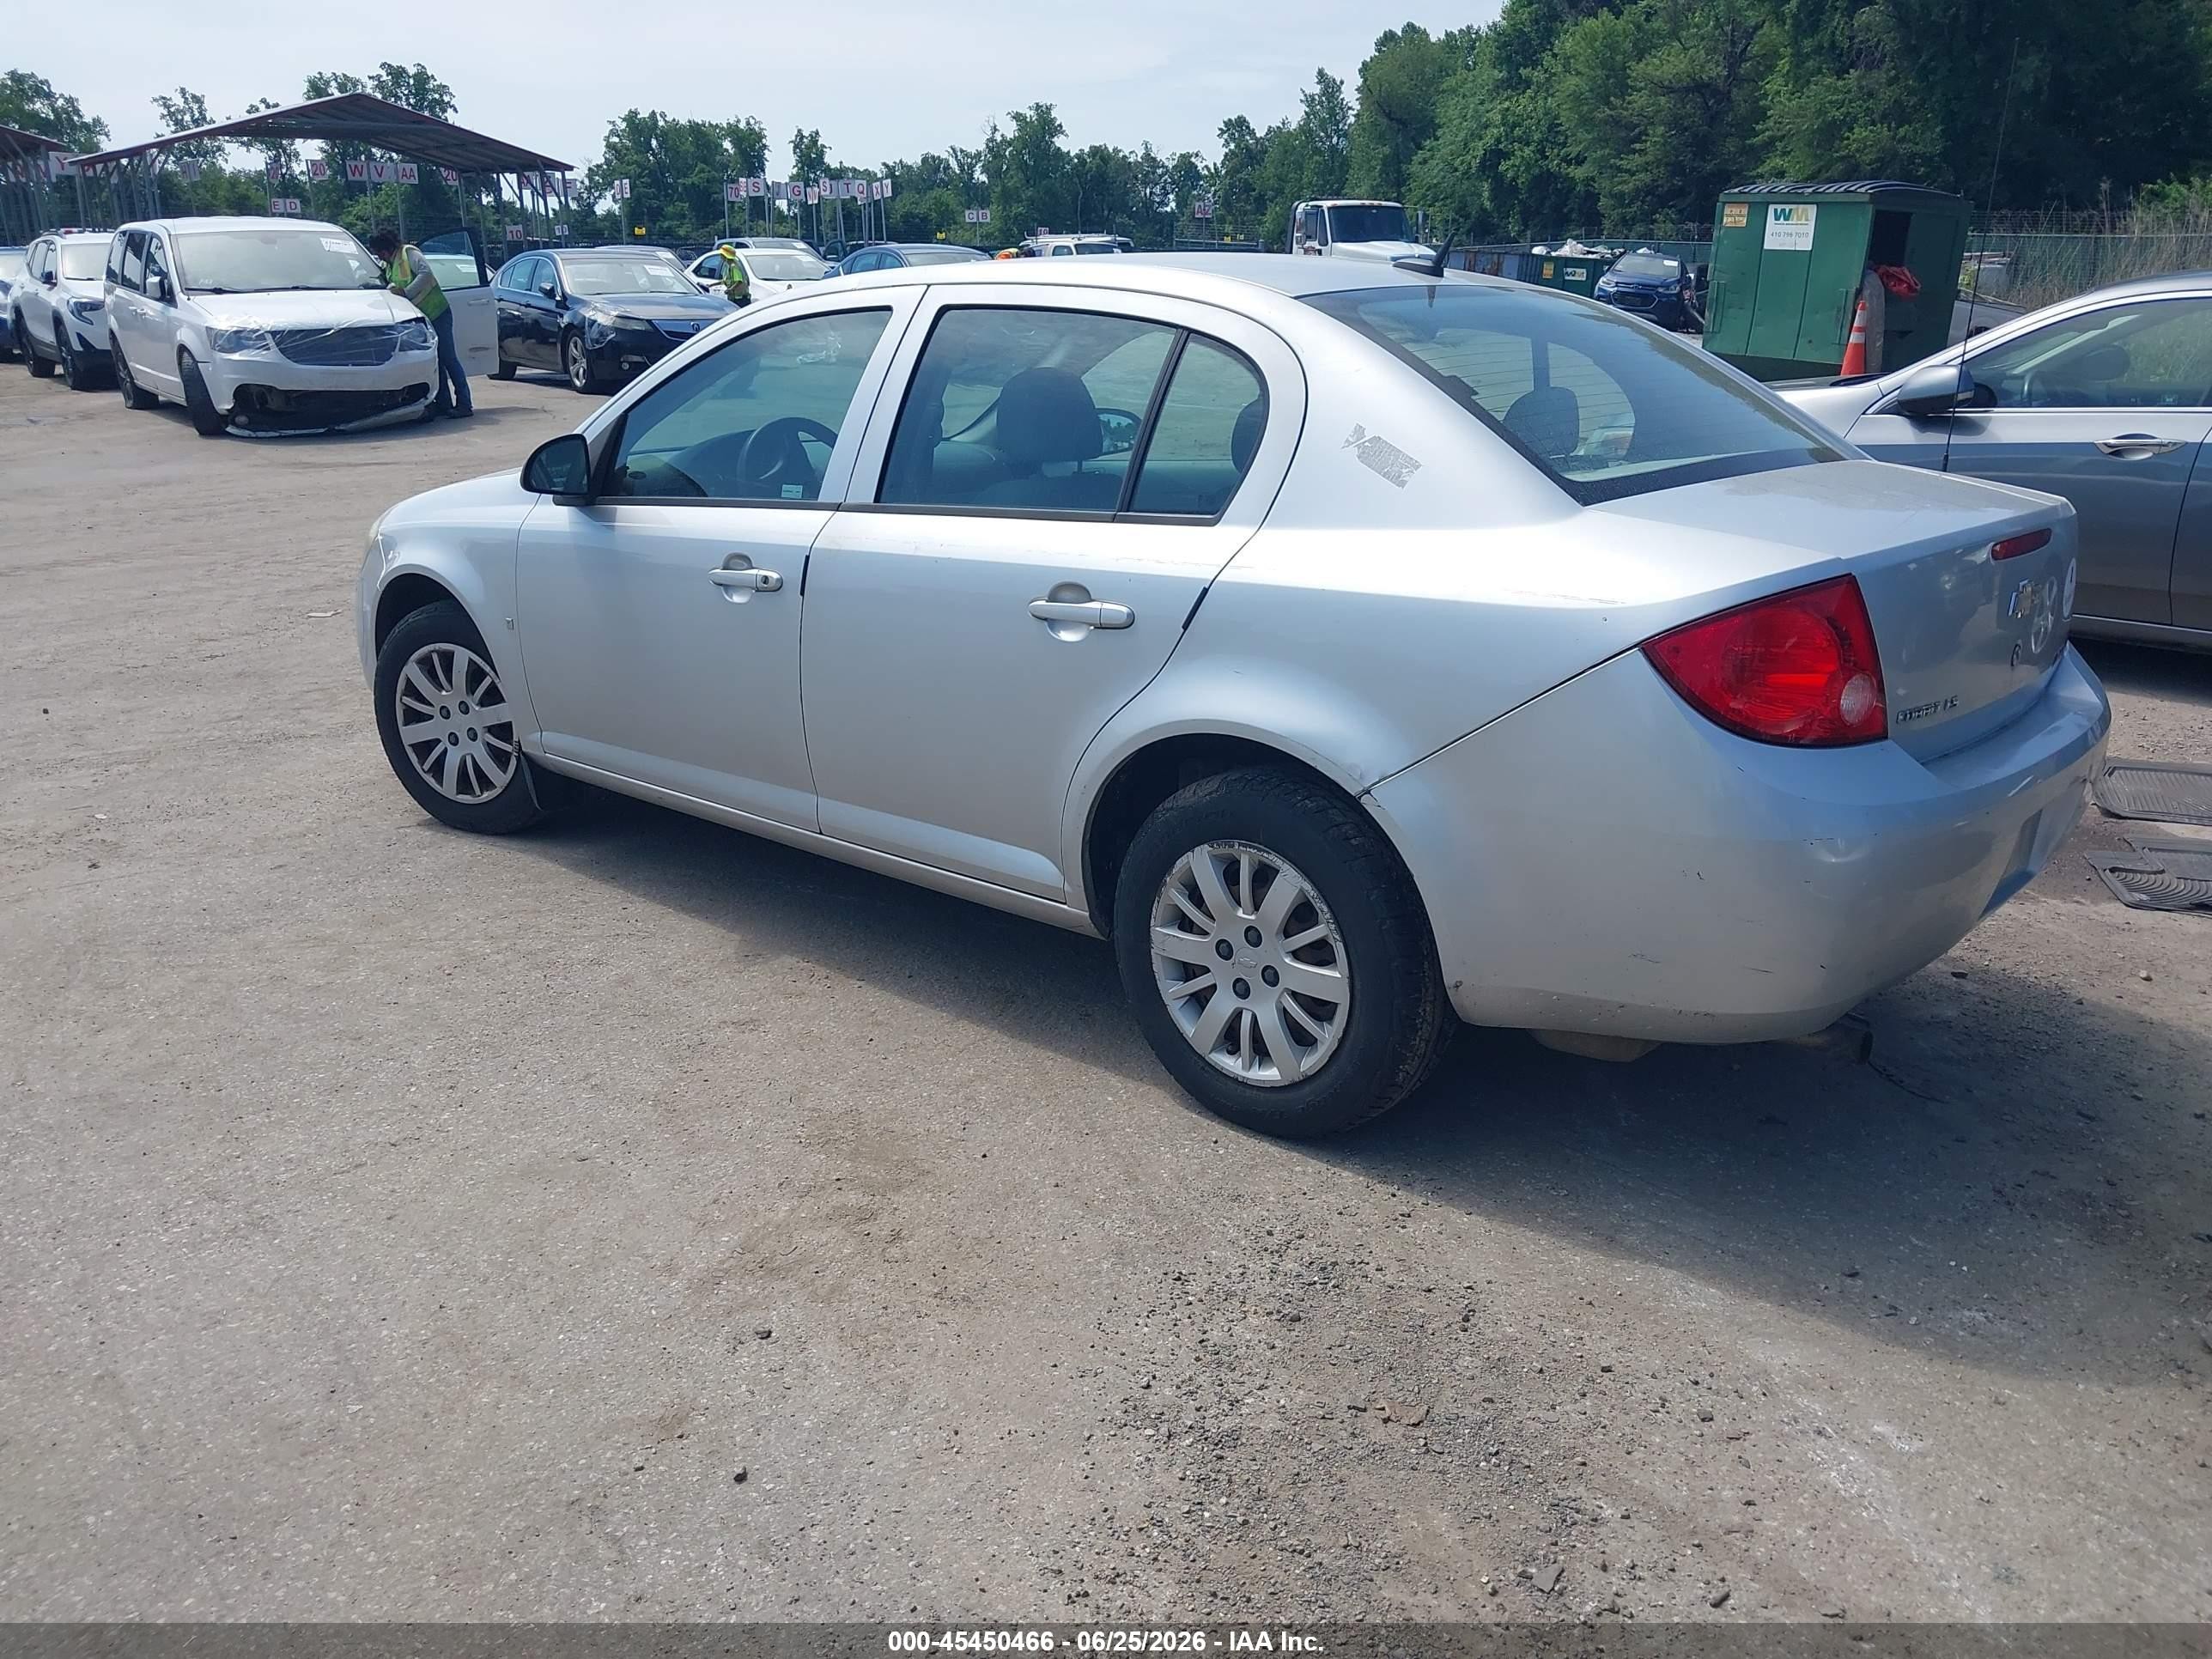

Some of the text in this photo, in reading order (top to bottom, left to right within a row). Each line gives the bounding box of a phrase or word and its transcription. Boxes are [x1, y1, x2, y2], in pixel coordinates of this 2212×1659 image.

[311, 163, 326, 176] 20
[349, 164, 364, 177] W
[374, 164, 385, 178] V
[401, 167, 416, 180] AA
[728, 186, 739, 198] 70
[751, 181, 761, 193] S
[792, 185, 802, 197] G
[843, 182, 852, 193] T
[857, 183, 866, 196] Q
[874, 184, 880, 197] X
[884, 181, 890, 194] Y
[272, 200, 297, 210] E D
[967, 211, 988, 221] C B
[1773, 208, 1810, 222] WM
[508, 229, 523, 240] 10
